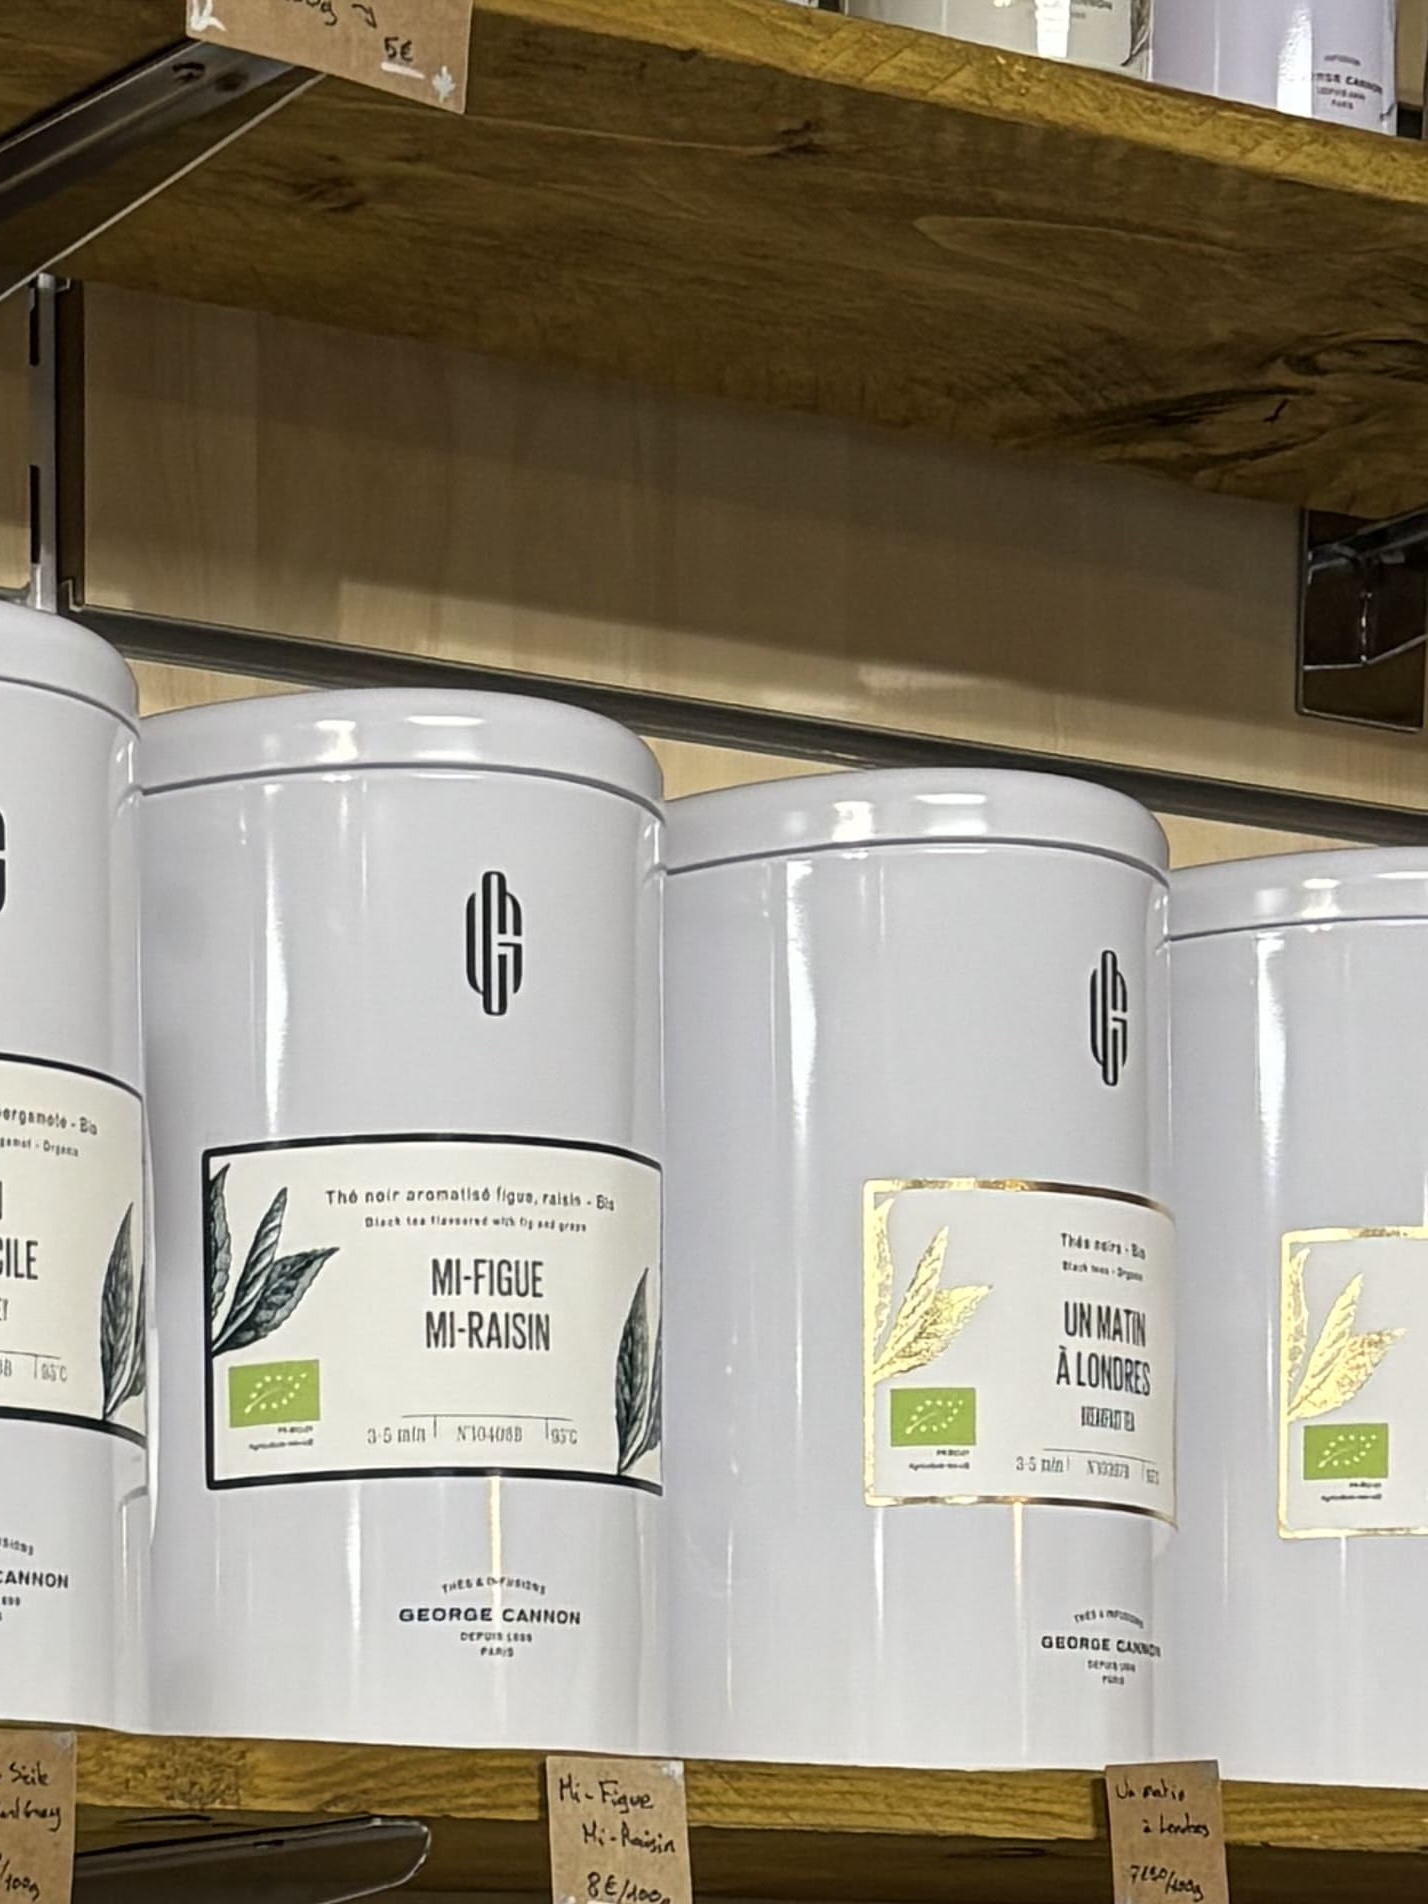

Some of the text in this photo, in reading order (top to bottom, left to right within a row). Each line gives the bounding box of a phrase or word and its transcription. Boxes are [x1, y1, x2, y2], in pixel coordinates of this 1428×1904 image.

[384, 36, 412, 62] 5€
[326, 1190, 358, 1204] Thé
[365, 1190, 399, 1203] noir
[432, 1259, 543, 1298] MI-FIGUE
[426, 1311, 549, 1351] MI-RAISIN
[1065, 1301, 1145, 1347] UN MATIN
[1056, 1345, 1150, 1396] À LONDRES
[399, 1608, 580, 1624] GEORGE CANNON
[1041, 1636, 1160, 1657] GEORGE CANNON
